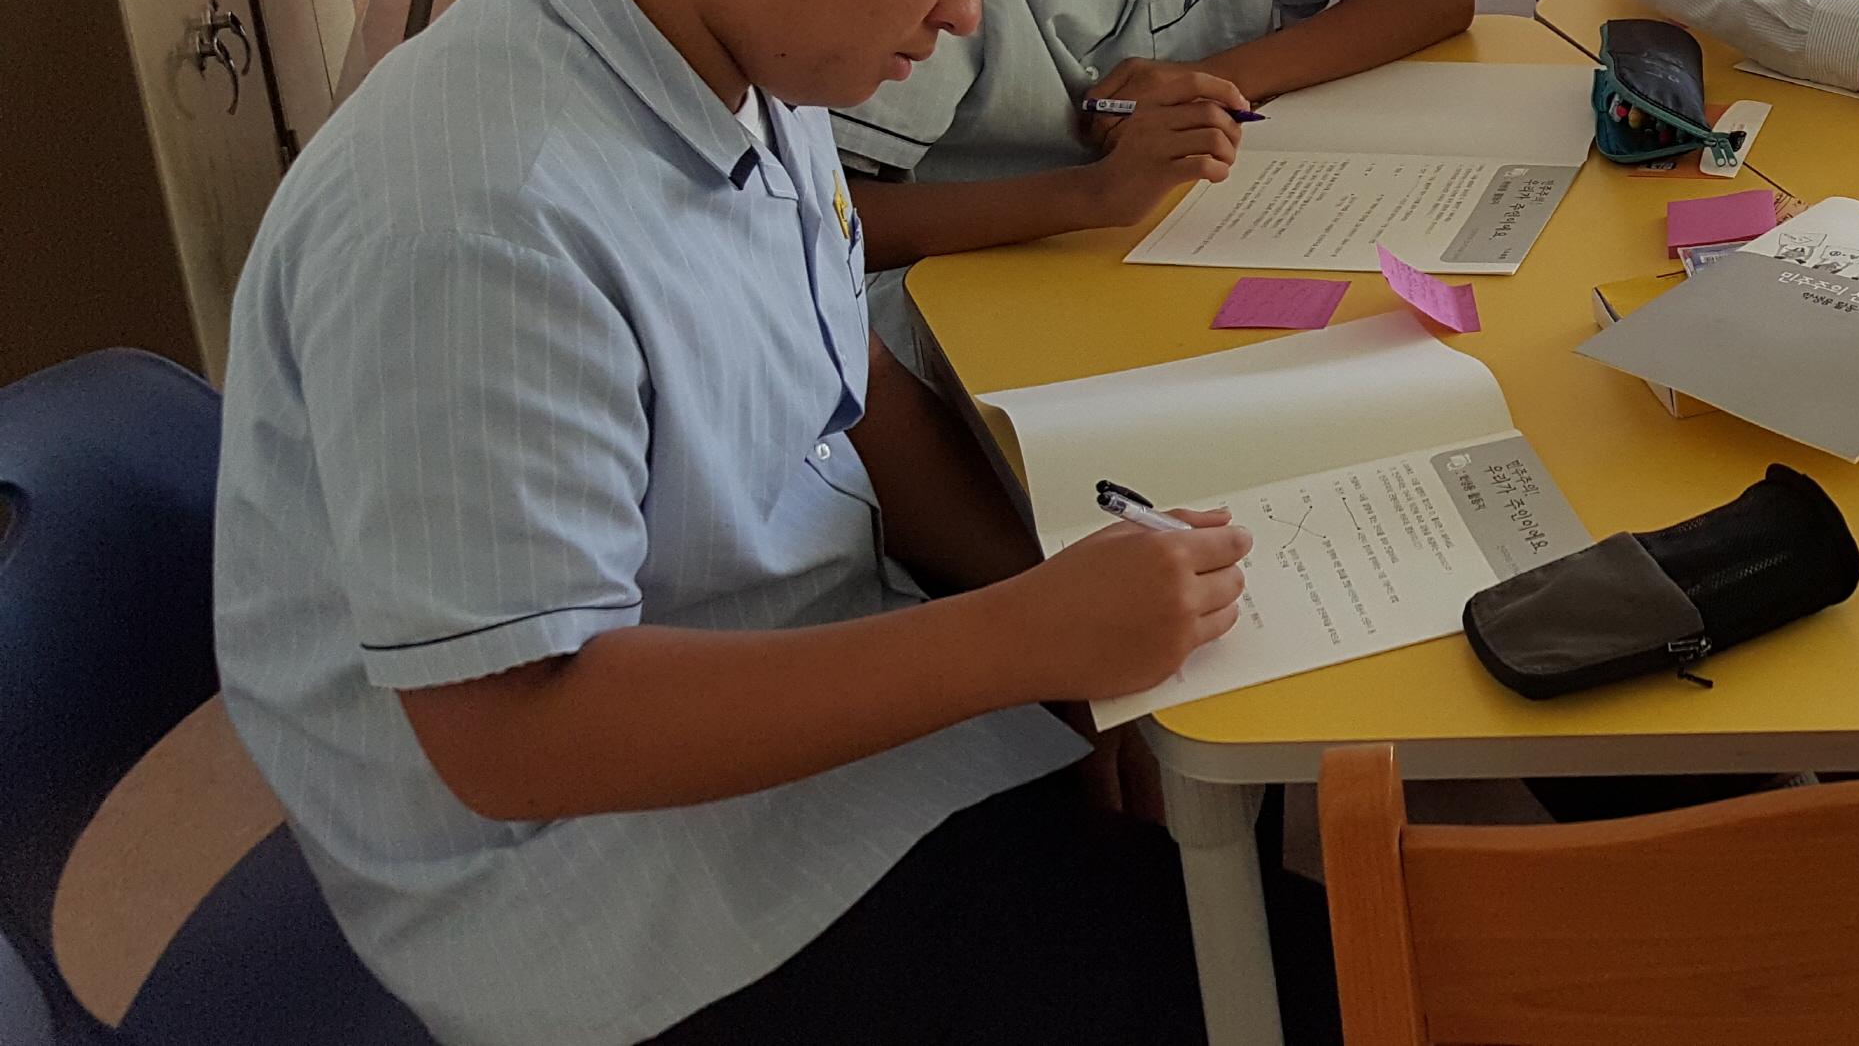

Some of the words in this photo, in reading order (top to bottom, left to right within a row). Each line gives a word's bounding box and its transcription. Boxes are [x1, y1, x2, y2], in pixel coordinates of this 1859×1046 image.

[1512, 179, 1541, 199] 우리가
[1778, 271, 1849, 295] 민주주의
[1502, 458, 1542, 497] 민주주의!
[1479, 462, 1518, 496] 우리가
[1500, 496, 1554, 554] 주인이에요.
